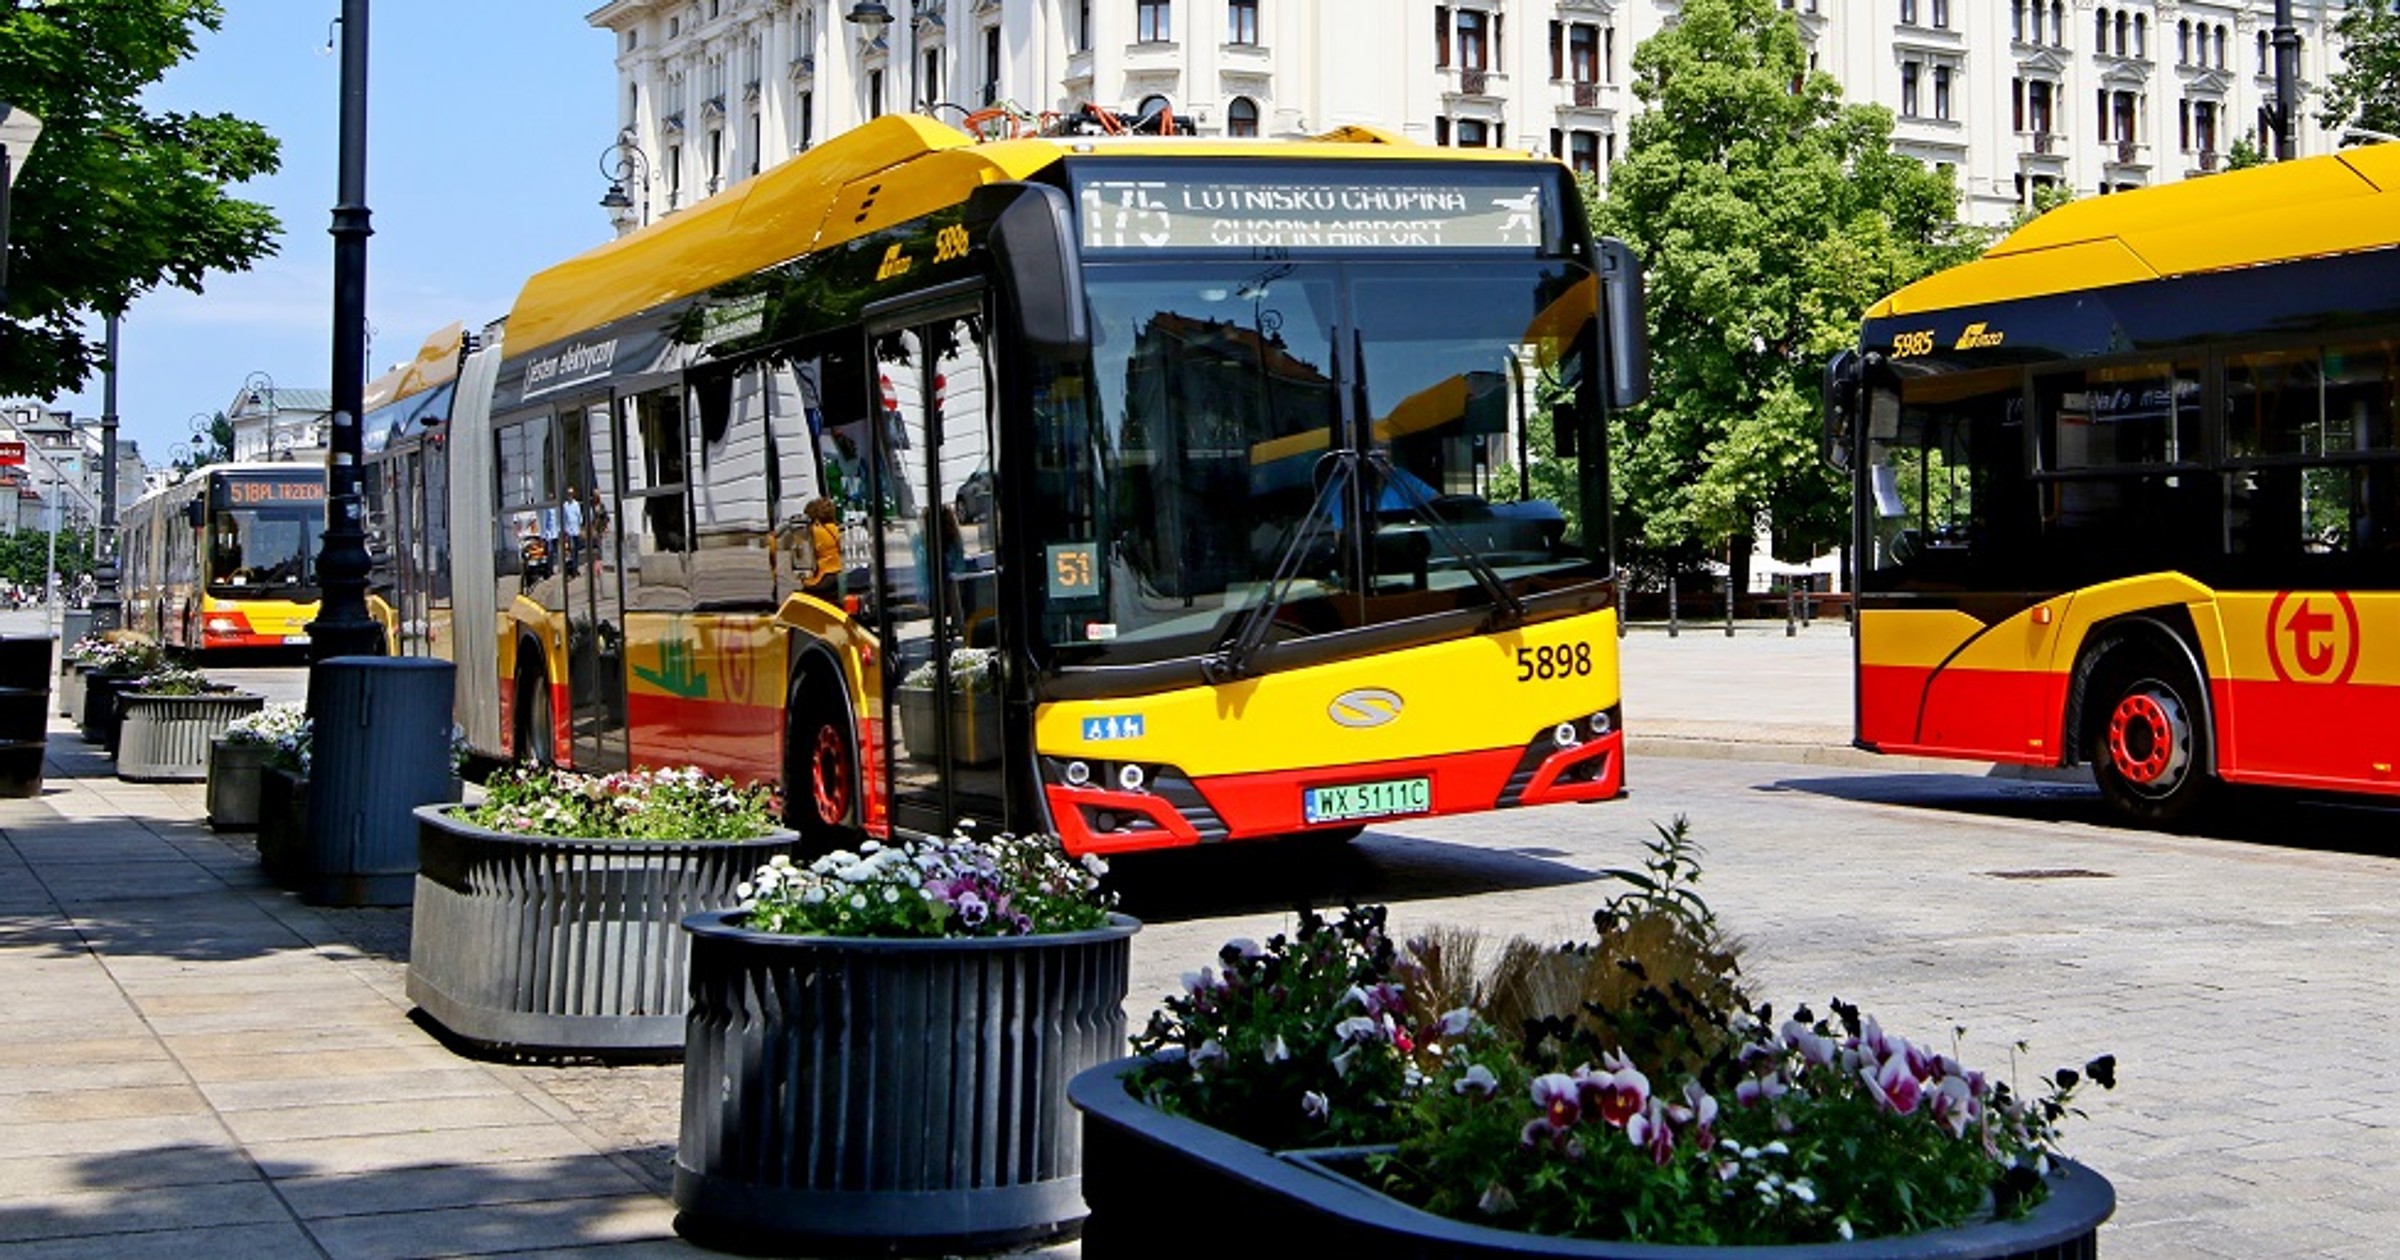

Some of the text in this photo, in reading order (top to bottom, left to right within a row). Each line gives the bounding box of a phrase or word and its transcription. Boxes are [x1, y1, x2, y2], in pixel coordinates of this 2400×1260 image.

[1081, 182, 1170, 246] 175
[1183, 184, 1466, 211] LOTNISKO CHOPINA
[1211, 218, 1442, 246] CHOPIN AIRPORT
[1891, 329, 1934, 359] 5985
[1056, 551, 1091, 588] 51
[1517, 641, 1592, 682] 5898
[1320, 789, 1349, 814] WX
[1358, 781, 1424, 811] 5111C
